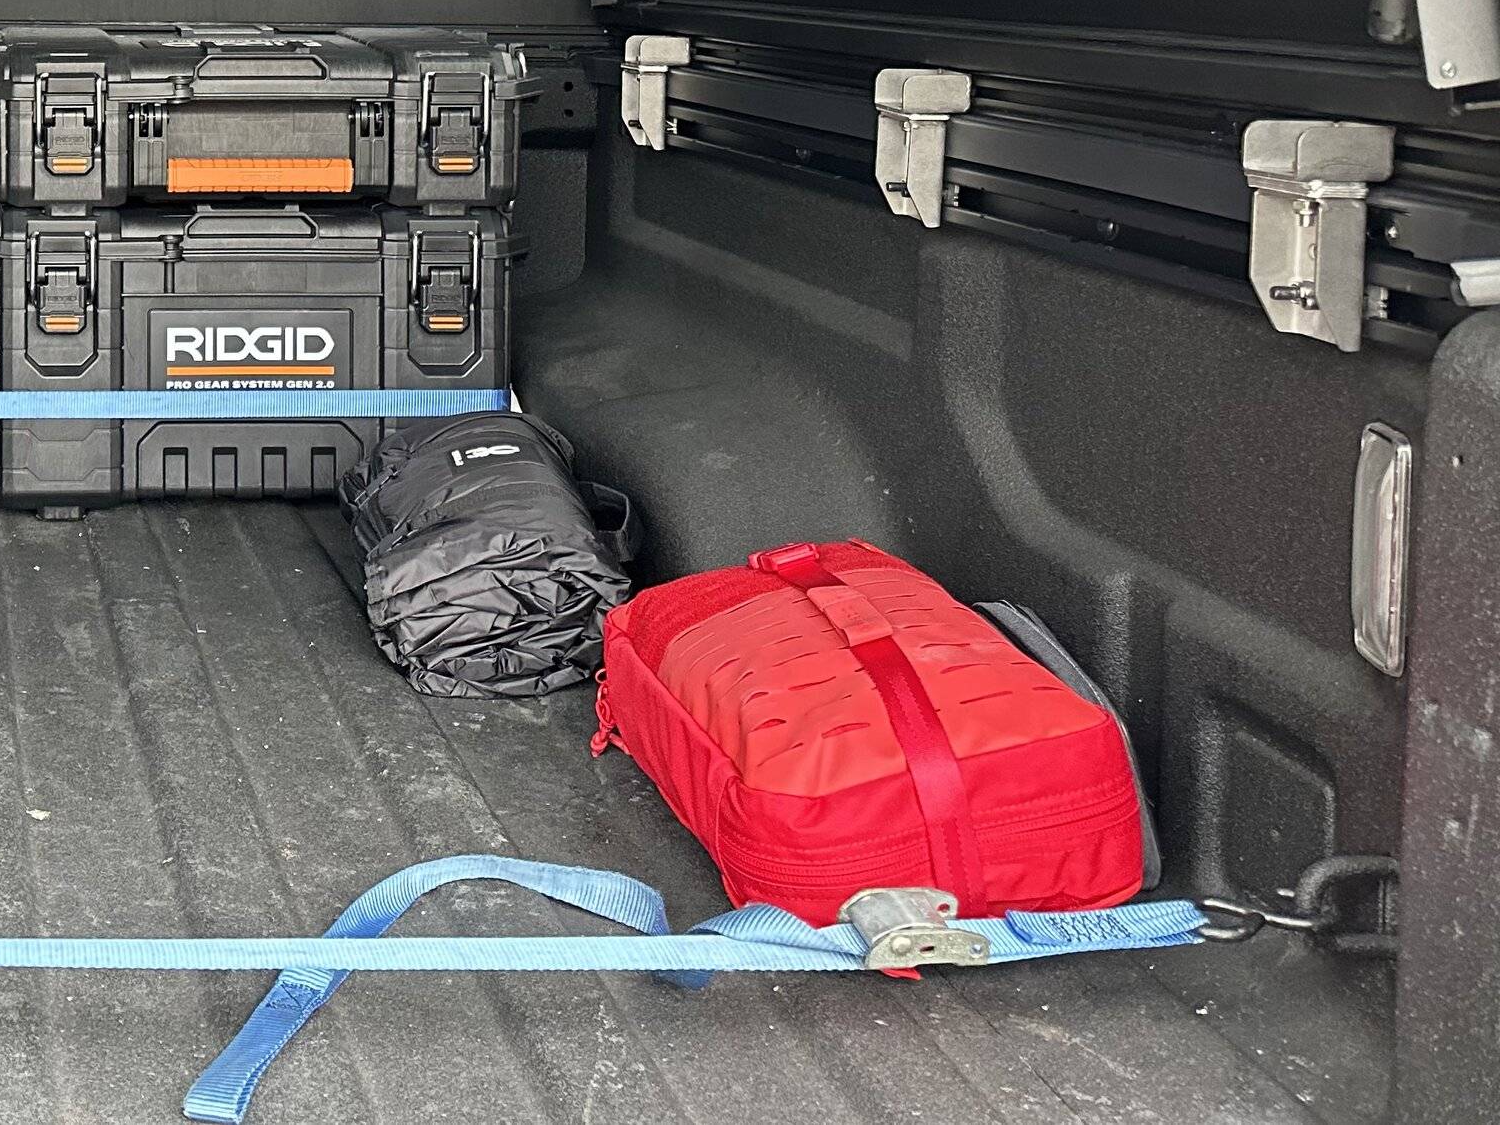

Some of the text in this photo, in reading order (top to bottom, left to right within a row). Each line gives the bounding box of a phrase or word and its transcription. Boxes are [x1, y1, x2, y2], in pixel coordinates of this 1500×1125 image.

[166, 326, 335, 362] RIDGID
[165, 380, 335, 390] PRO GEAR SYSTEM GEN 2.0
